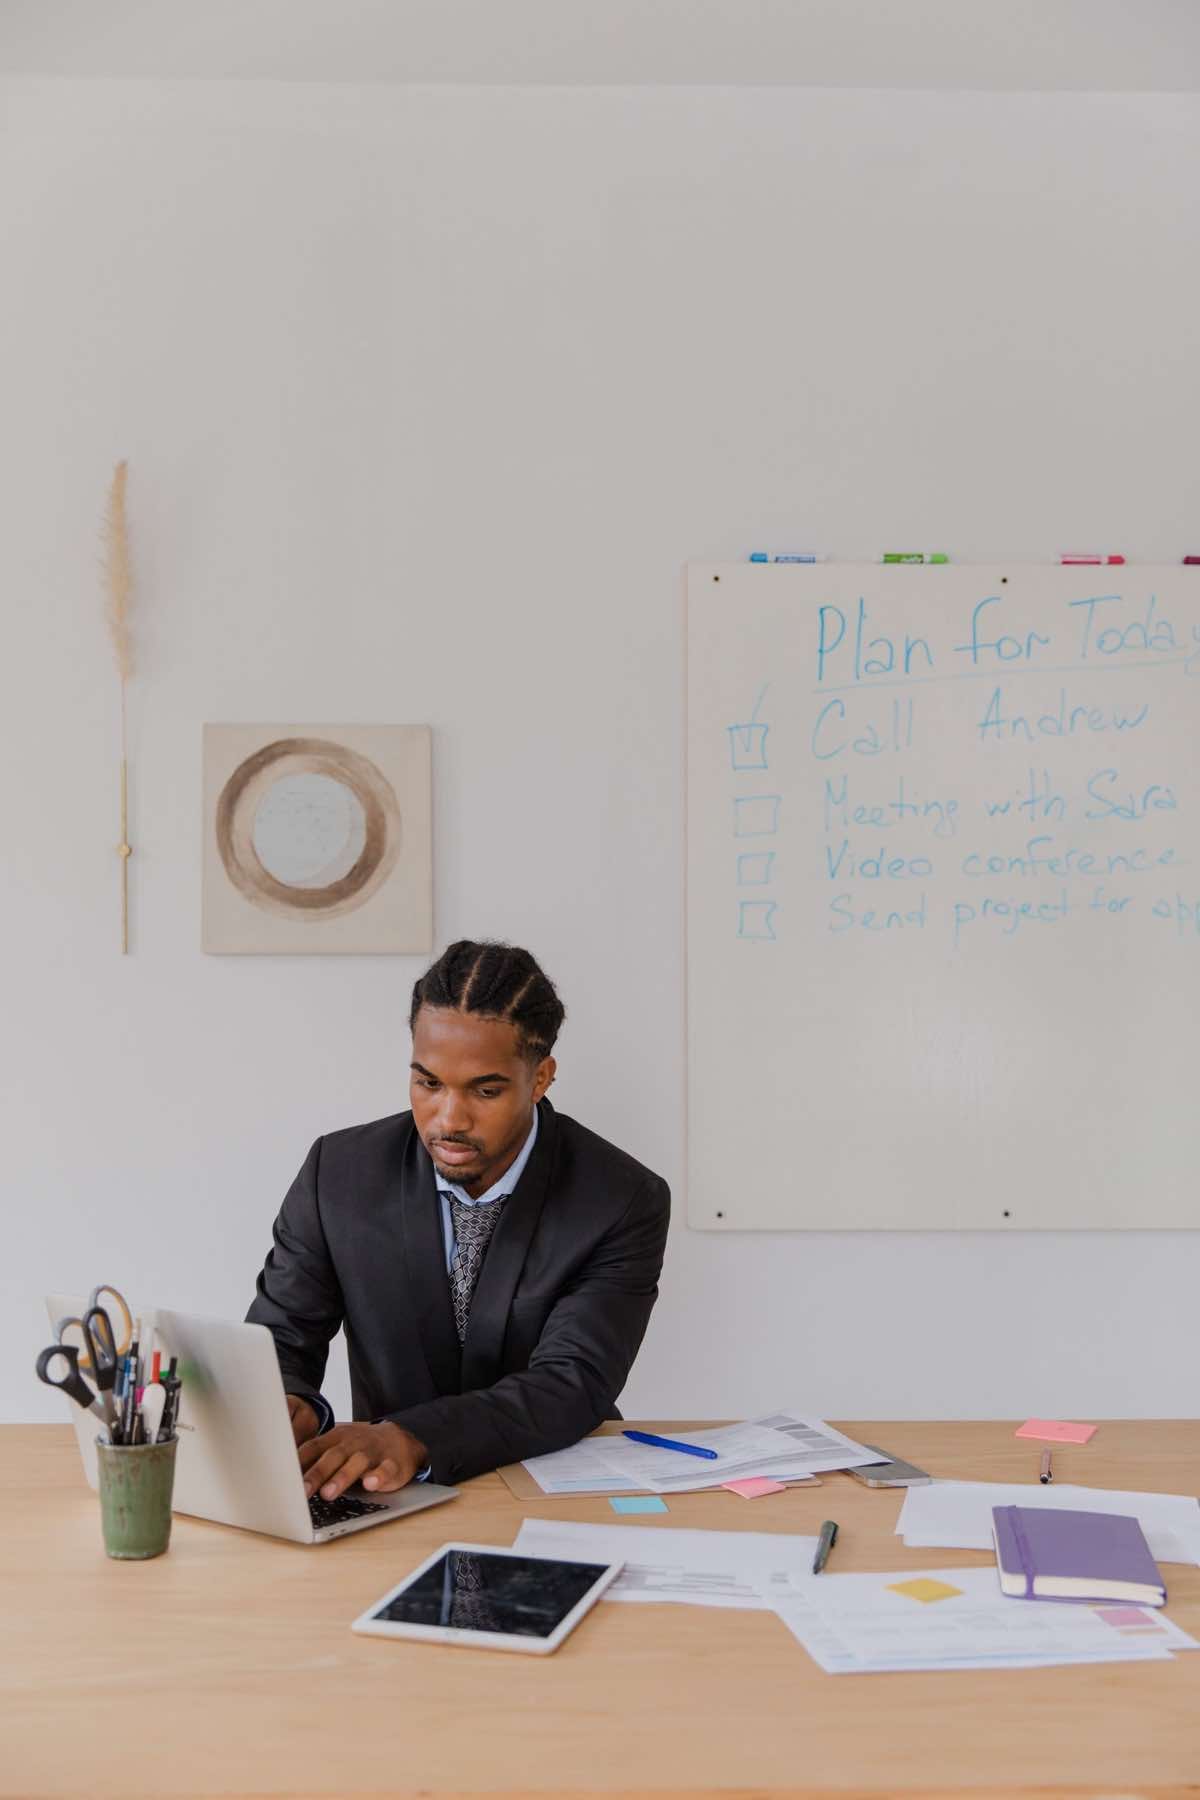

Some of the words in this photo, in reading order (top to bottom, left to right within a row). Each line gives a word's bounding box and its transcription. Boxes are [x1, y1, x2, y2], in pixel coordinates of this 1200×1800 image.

[817, 596, 933, 680] Plan
[953, 595, 1050, 664] for
[811, 698, 913, 760] Call
[977, 686, 1150, 742] Andrew
[824, 773, 958, 838] Meeting
[984, 767, 1066, 823] with
[1085, 768, 1177, 820] Sara
[825, 838, 934, 880] Video
[961, 836, 1176, 876] conference
[829, 893, 927, 932] Send
[954, 886, 1070, 948] project
[1089, 883, 1134, 913] for
